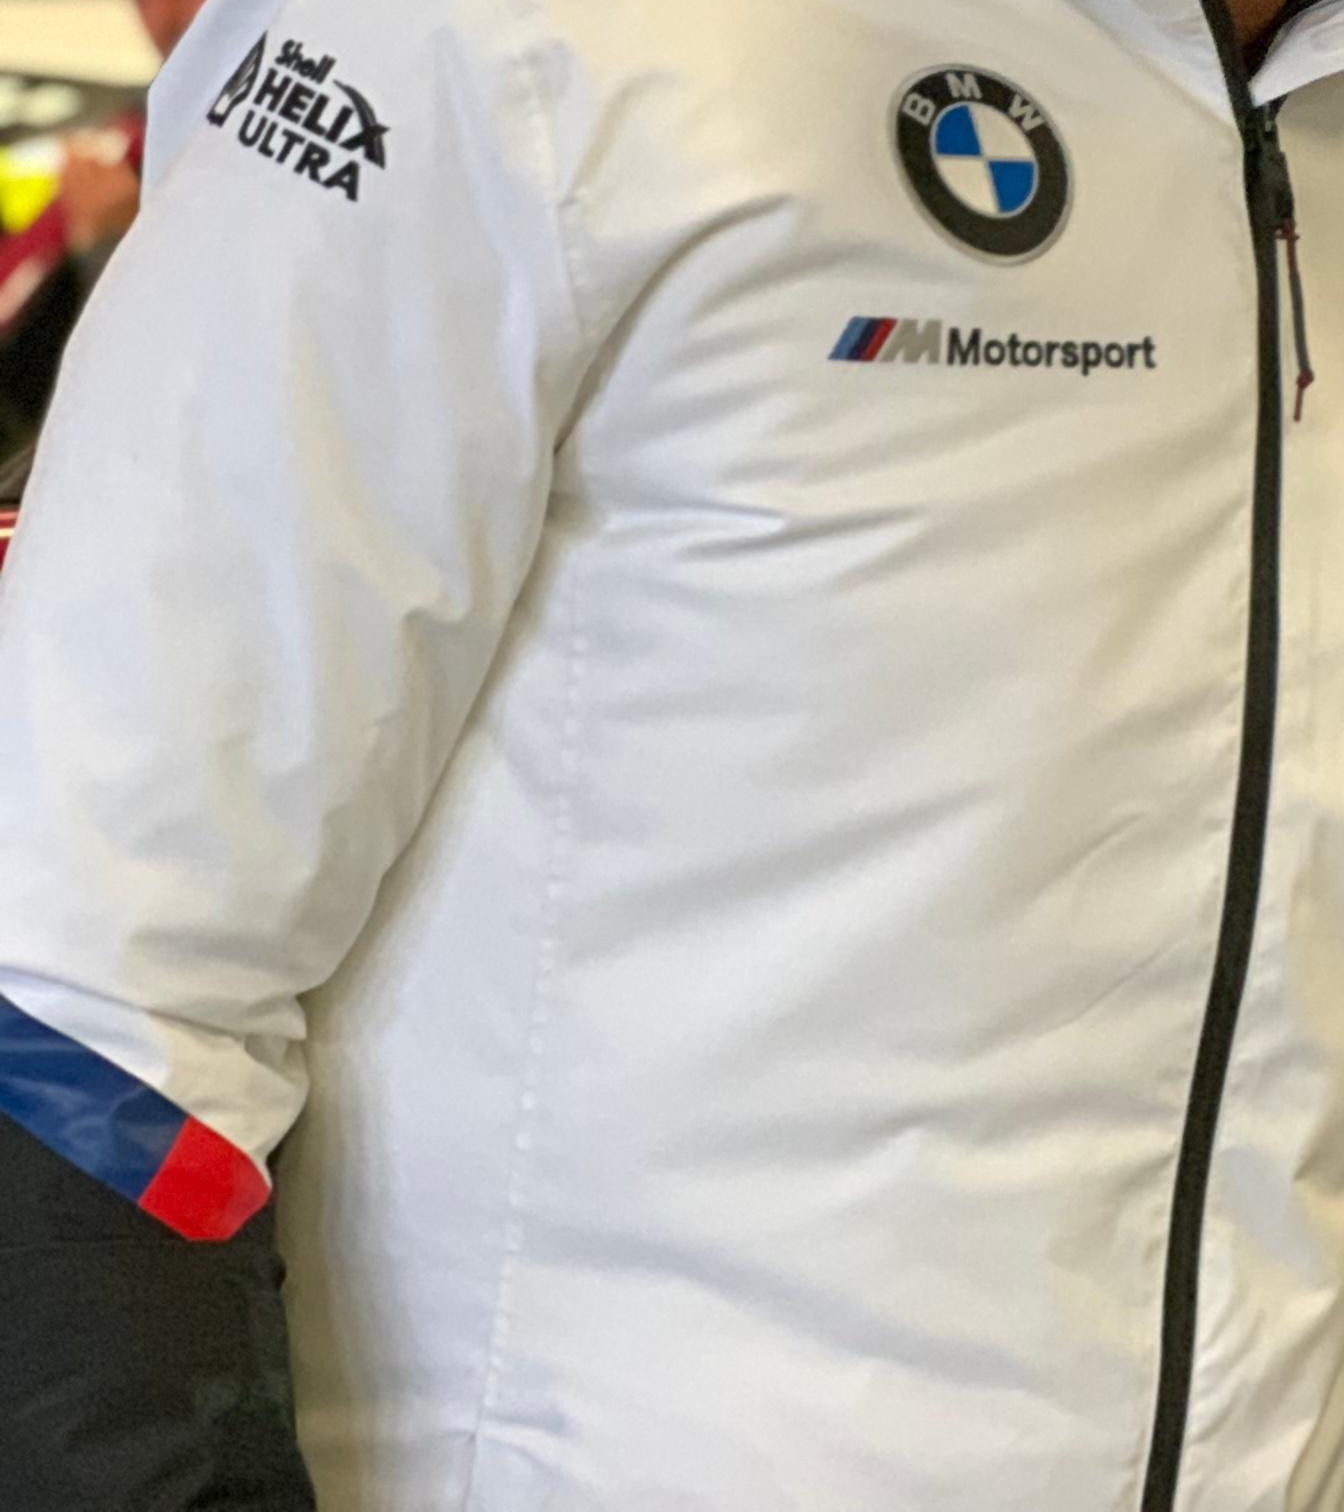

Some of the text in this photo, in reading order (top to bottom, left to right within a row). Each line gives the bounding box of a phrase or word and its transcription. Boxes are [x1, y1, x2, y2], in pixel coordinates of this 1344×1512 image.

[274, 39, 336, 84] Shell
[252, 67, 390, 170] HELIX
[902, 72, 1047, 131] BMW
[237, 109, 360, 202] ULTRA
[946, 326, 1157, 376] Motorsport
